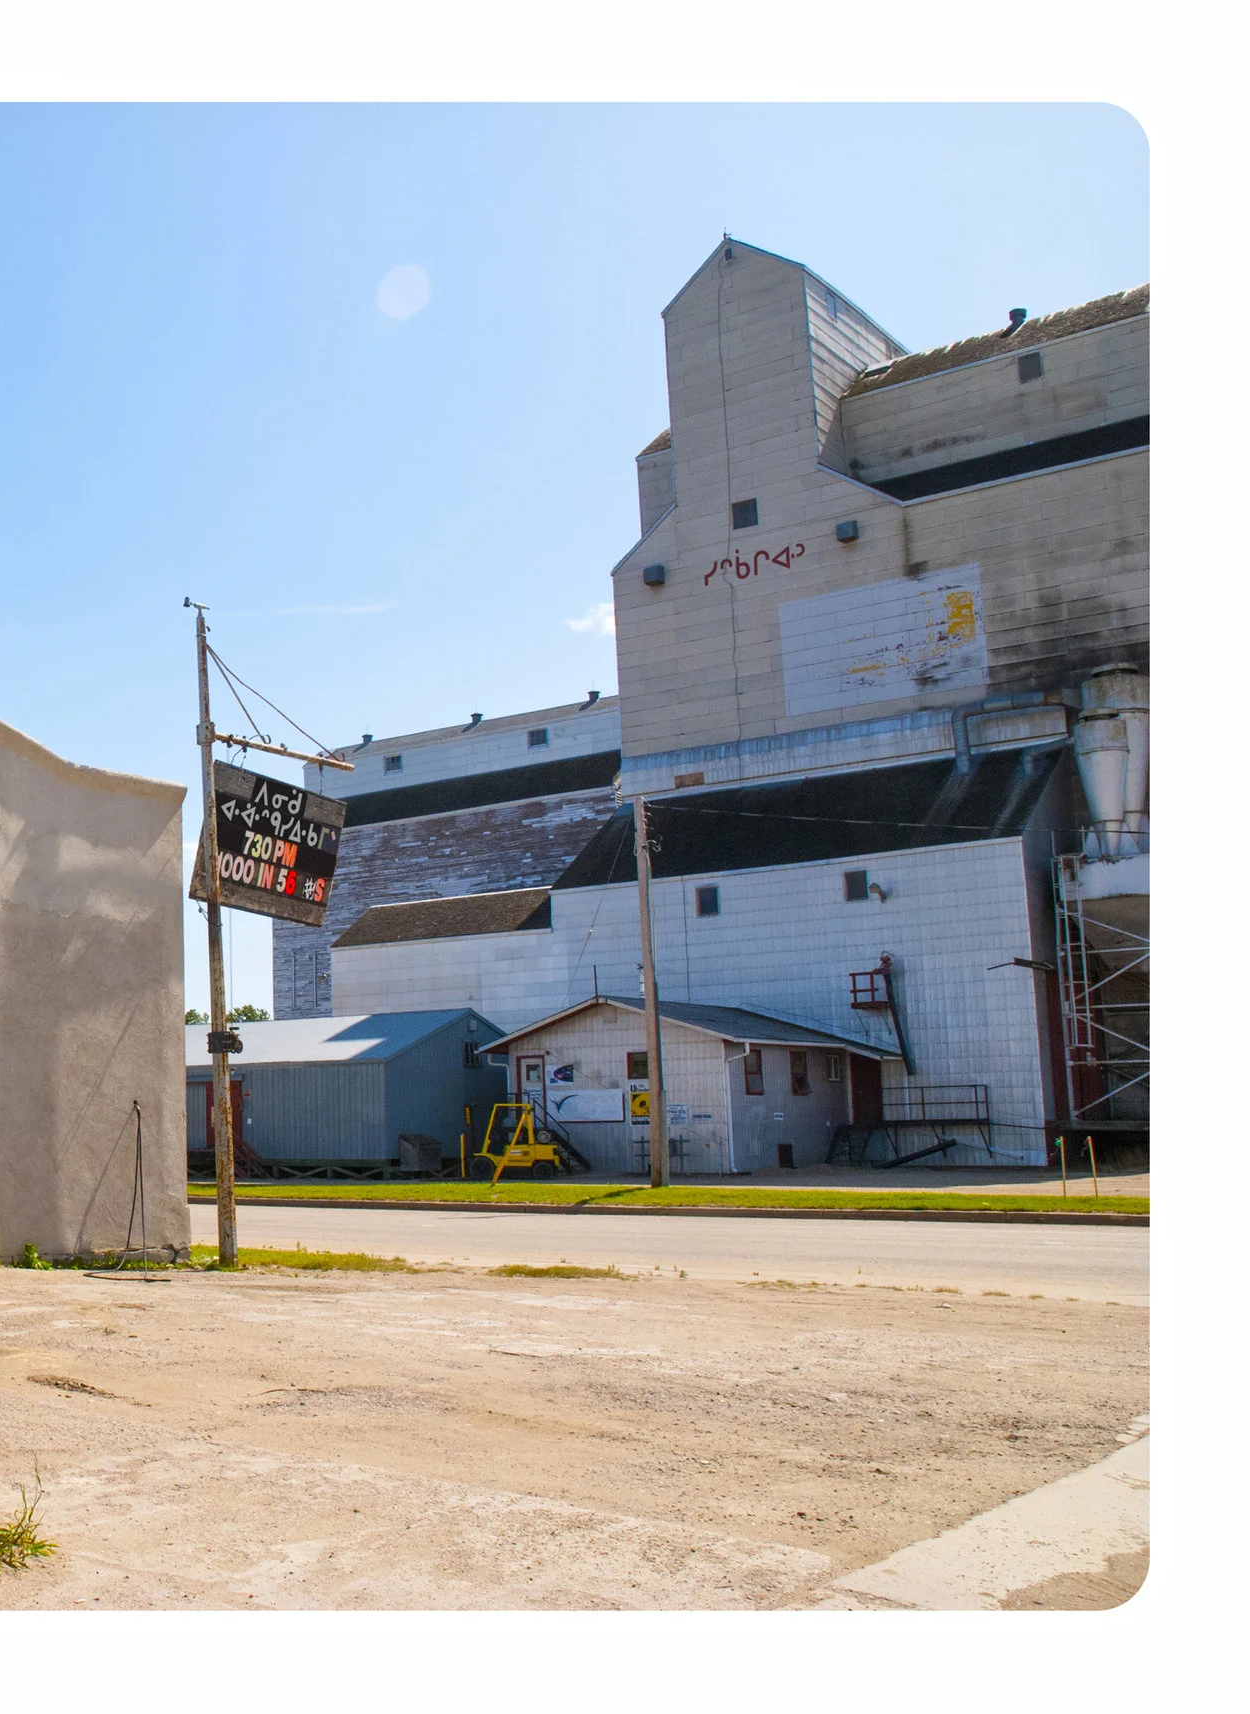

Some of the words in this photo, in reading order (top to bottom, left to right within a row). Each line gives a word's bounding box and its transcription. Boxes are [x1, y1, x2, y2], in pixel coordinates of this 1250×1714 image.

[243, 830, 272, 860] 730
[273, 839, 298, 867] PM
[256, 862, 275, 889] IN
[276, 868, 297, 895] 56
